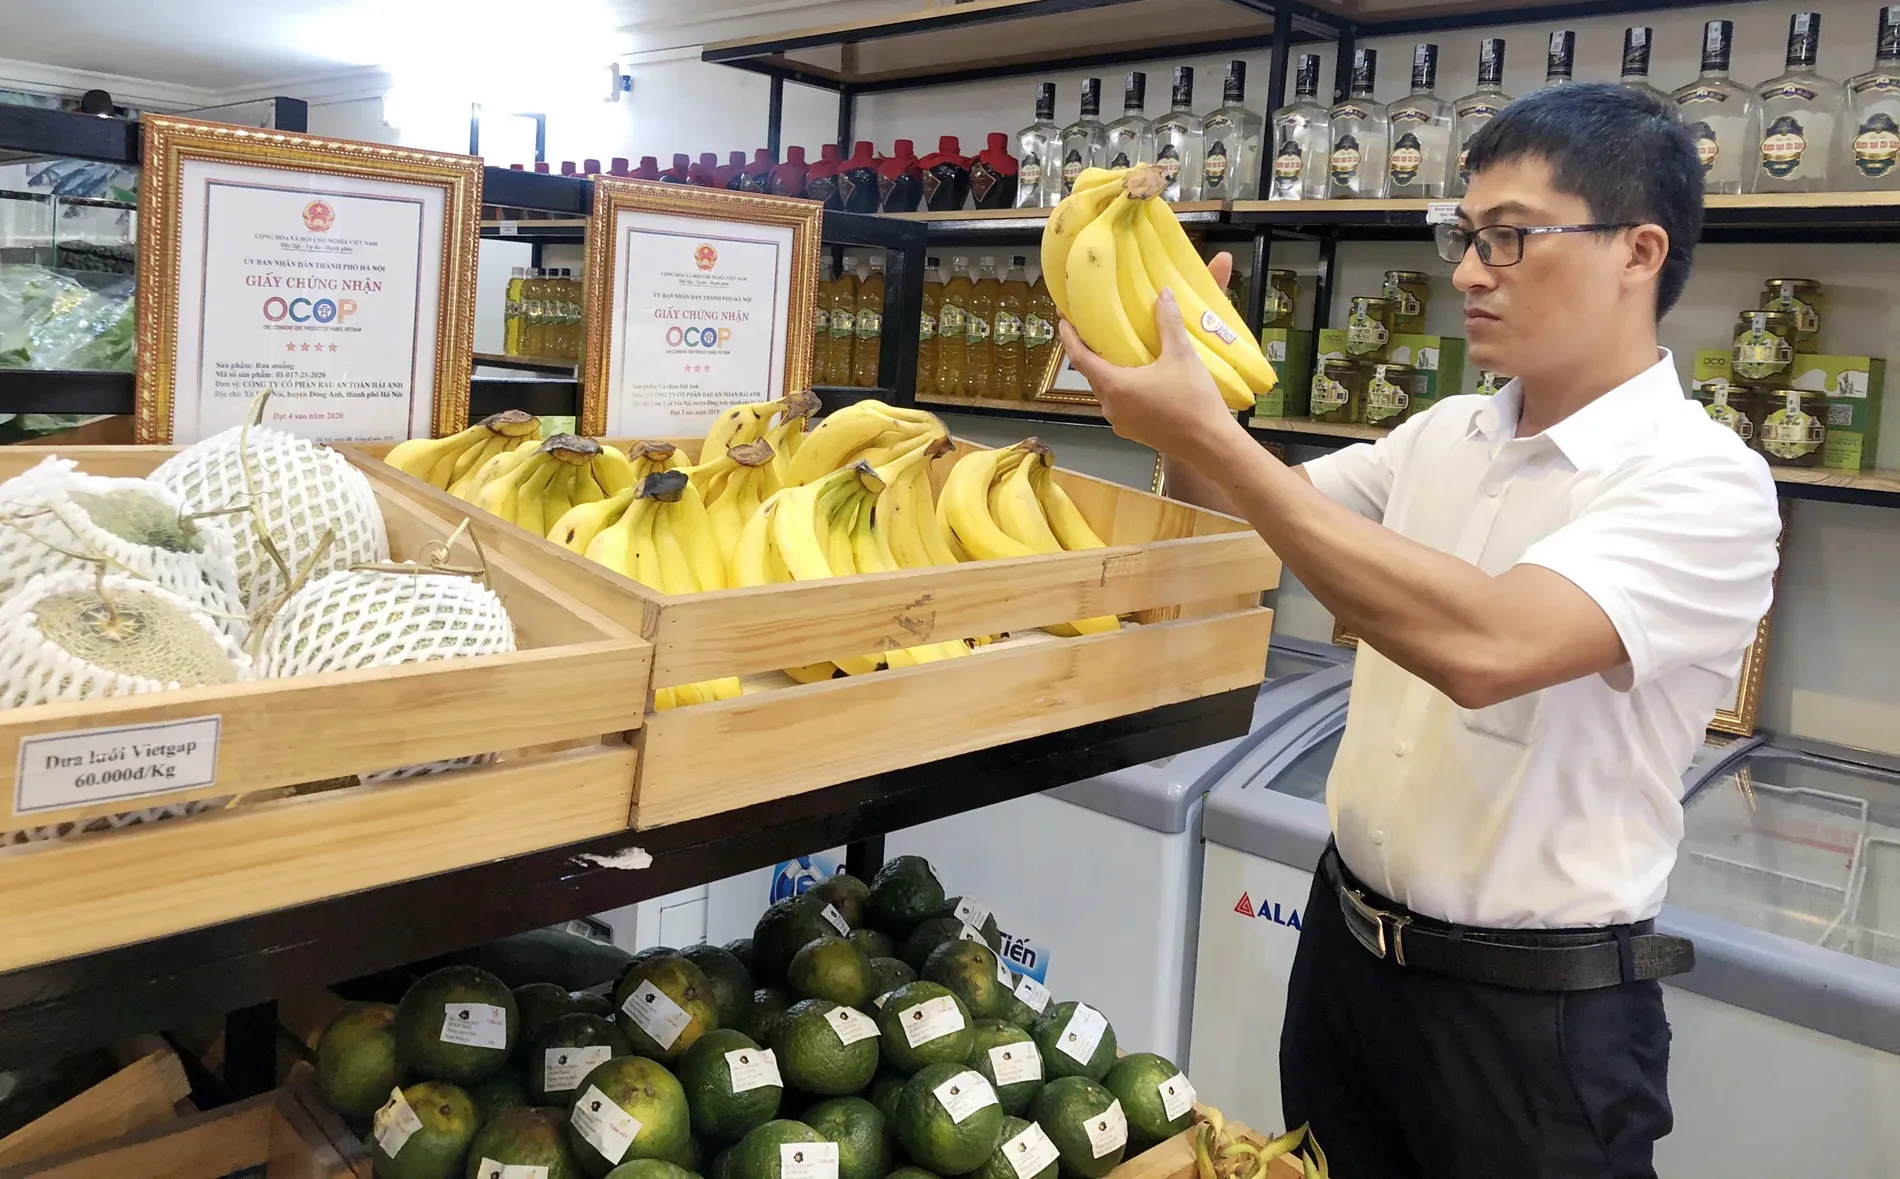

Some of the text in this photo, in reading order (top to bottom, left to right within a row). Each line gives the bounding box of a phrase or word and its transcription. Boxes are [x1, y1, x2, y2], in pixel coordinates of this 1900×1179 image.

[246, 272, 383, 295] GIẤY CHỨNG NHẬN
[263, 296, 358, 325] OCOP
[654, 305, 749, 324] GIẤY CHỨNG NHẬN
[666, 326, 732, 349] OCOP
[243, 379, 267, 389] CÔNG
[318, 381, 334, 389] RAU
[336, 381, 348, 389] AN
[386, 381, 404, 389] ANH
[276, 371, 326, 379] 01-017-25-2020
[288, 412, 293, 421] 4
[327, 412, 344, 421] 2020
[45, 754, 84, 771] Dưa
[132, 741, 197, 758] Vietgap
[75, 763, 176, 788] 60.000đ/Kg
